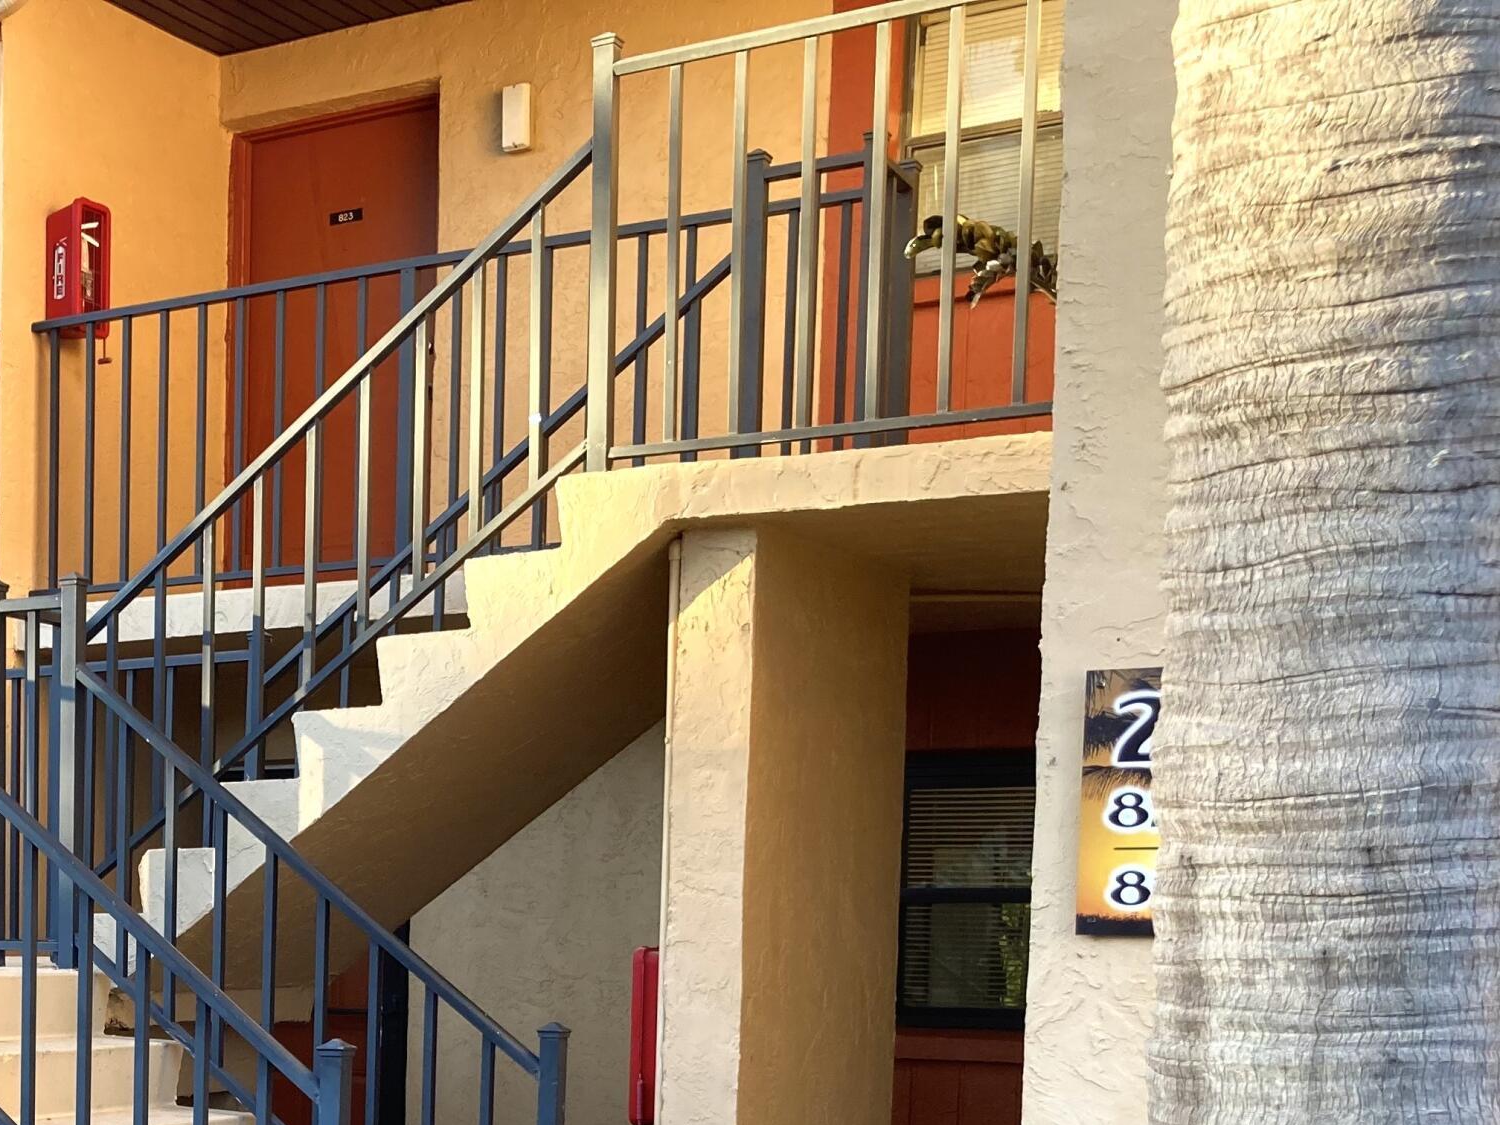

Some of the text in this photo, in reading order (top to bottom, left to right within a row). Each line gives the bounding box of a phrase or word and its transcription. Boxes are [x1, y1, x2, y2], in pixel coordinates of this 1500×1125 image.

[338, 212, 354, 222] 823
[56, 252, 64, 296] FIRE
[1114, 693, 1161, 765] 2
[1108, 792, 1157, 828] 8
